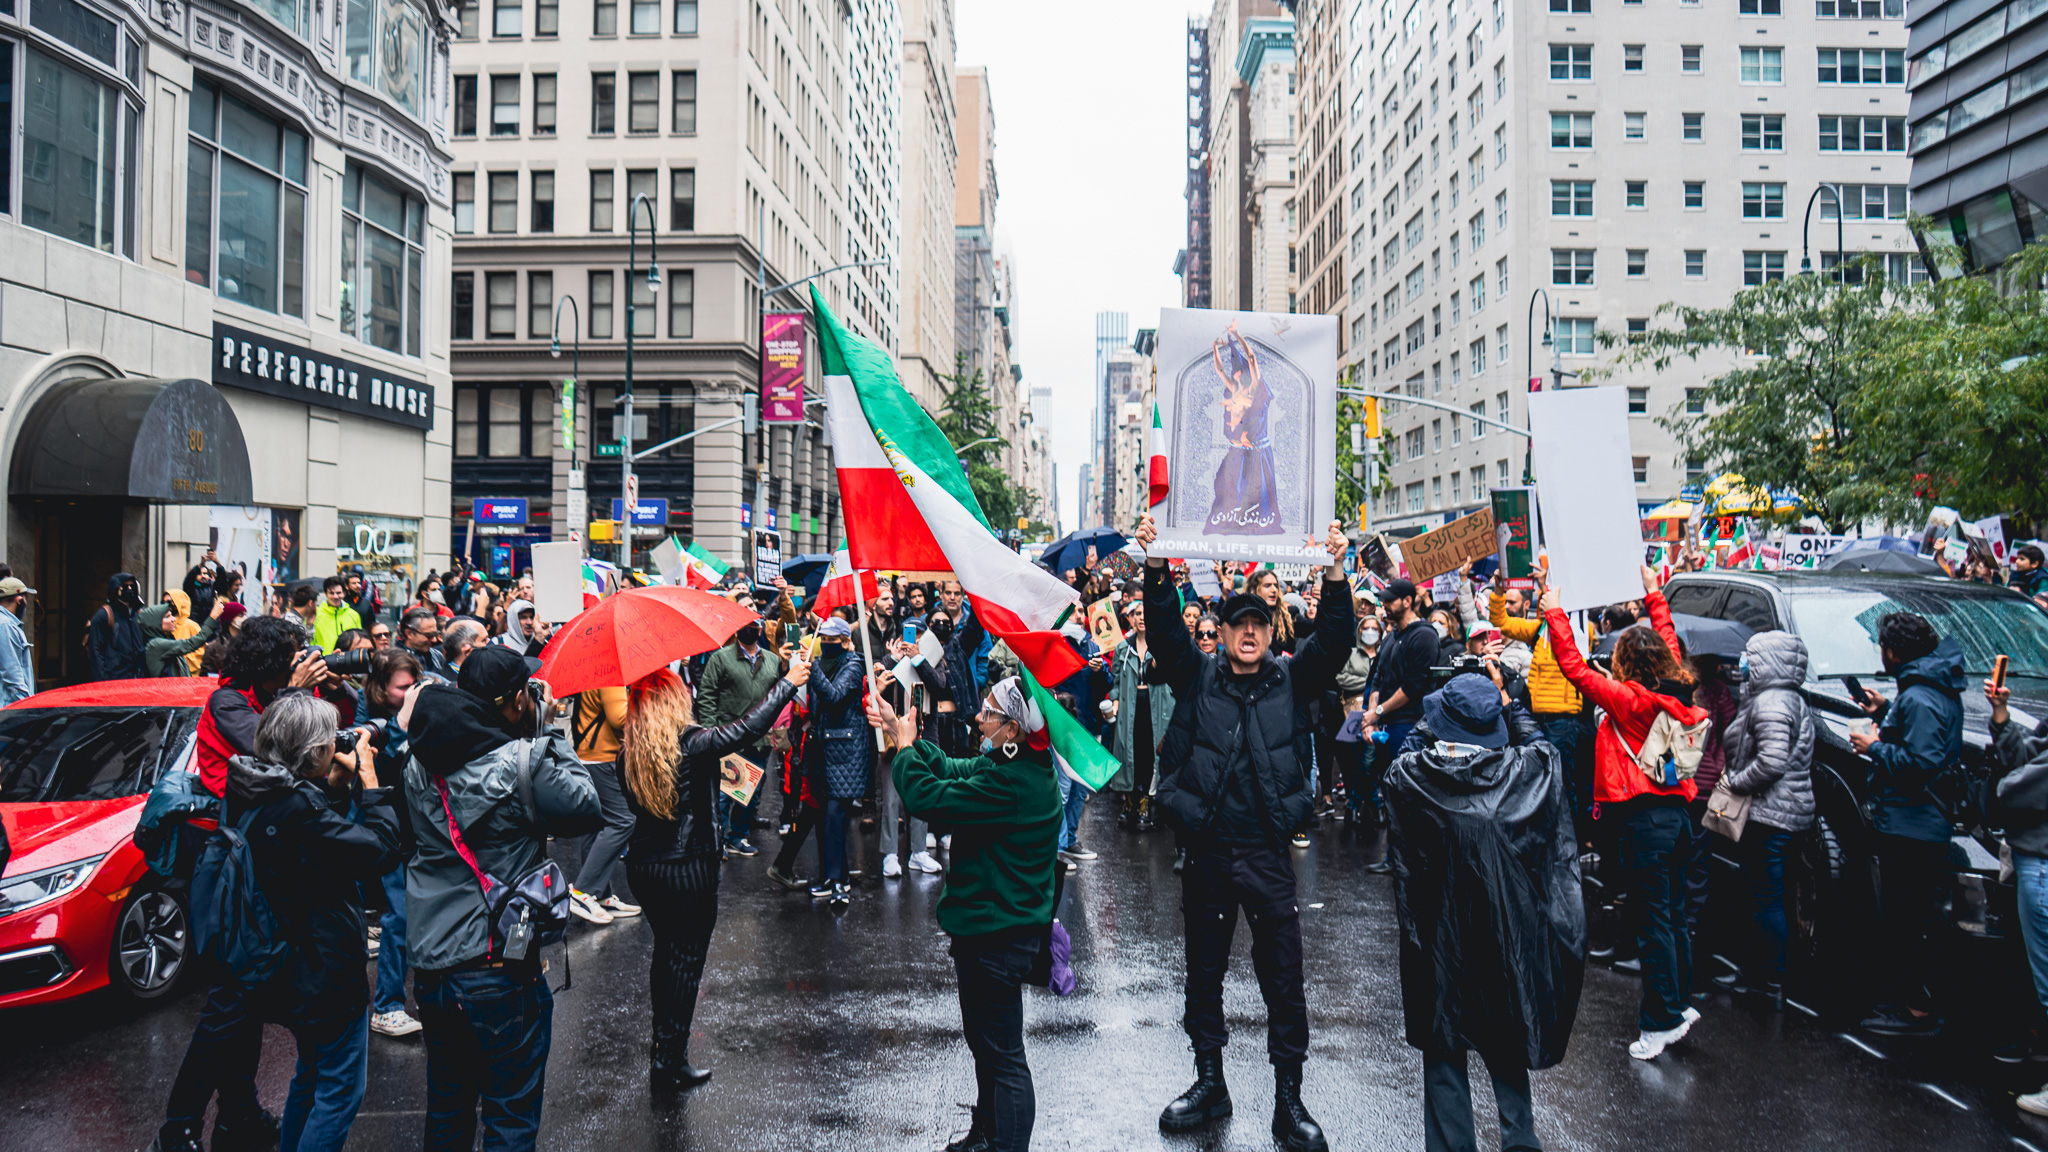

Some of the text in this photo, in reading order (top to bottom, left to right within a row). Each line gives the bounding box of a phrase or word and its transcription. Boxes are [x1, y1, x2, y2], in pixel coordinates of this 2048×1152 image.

[223, 336, 428, 418] PERFORMIX HOUSE
[189, 429, 204, 452] 80
[173, 479, 218, 494] FIFTH AVENUE
[757, 546, 780, 564] IRAN
[1153, 540, 1328, 558] WOMAN, LIFE, FREEDOM
